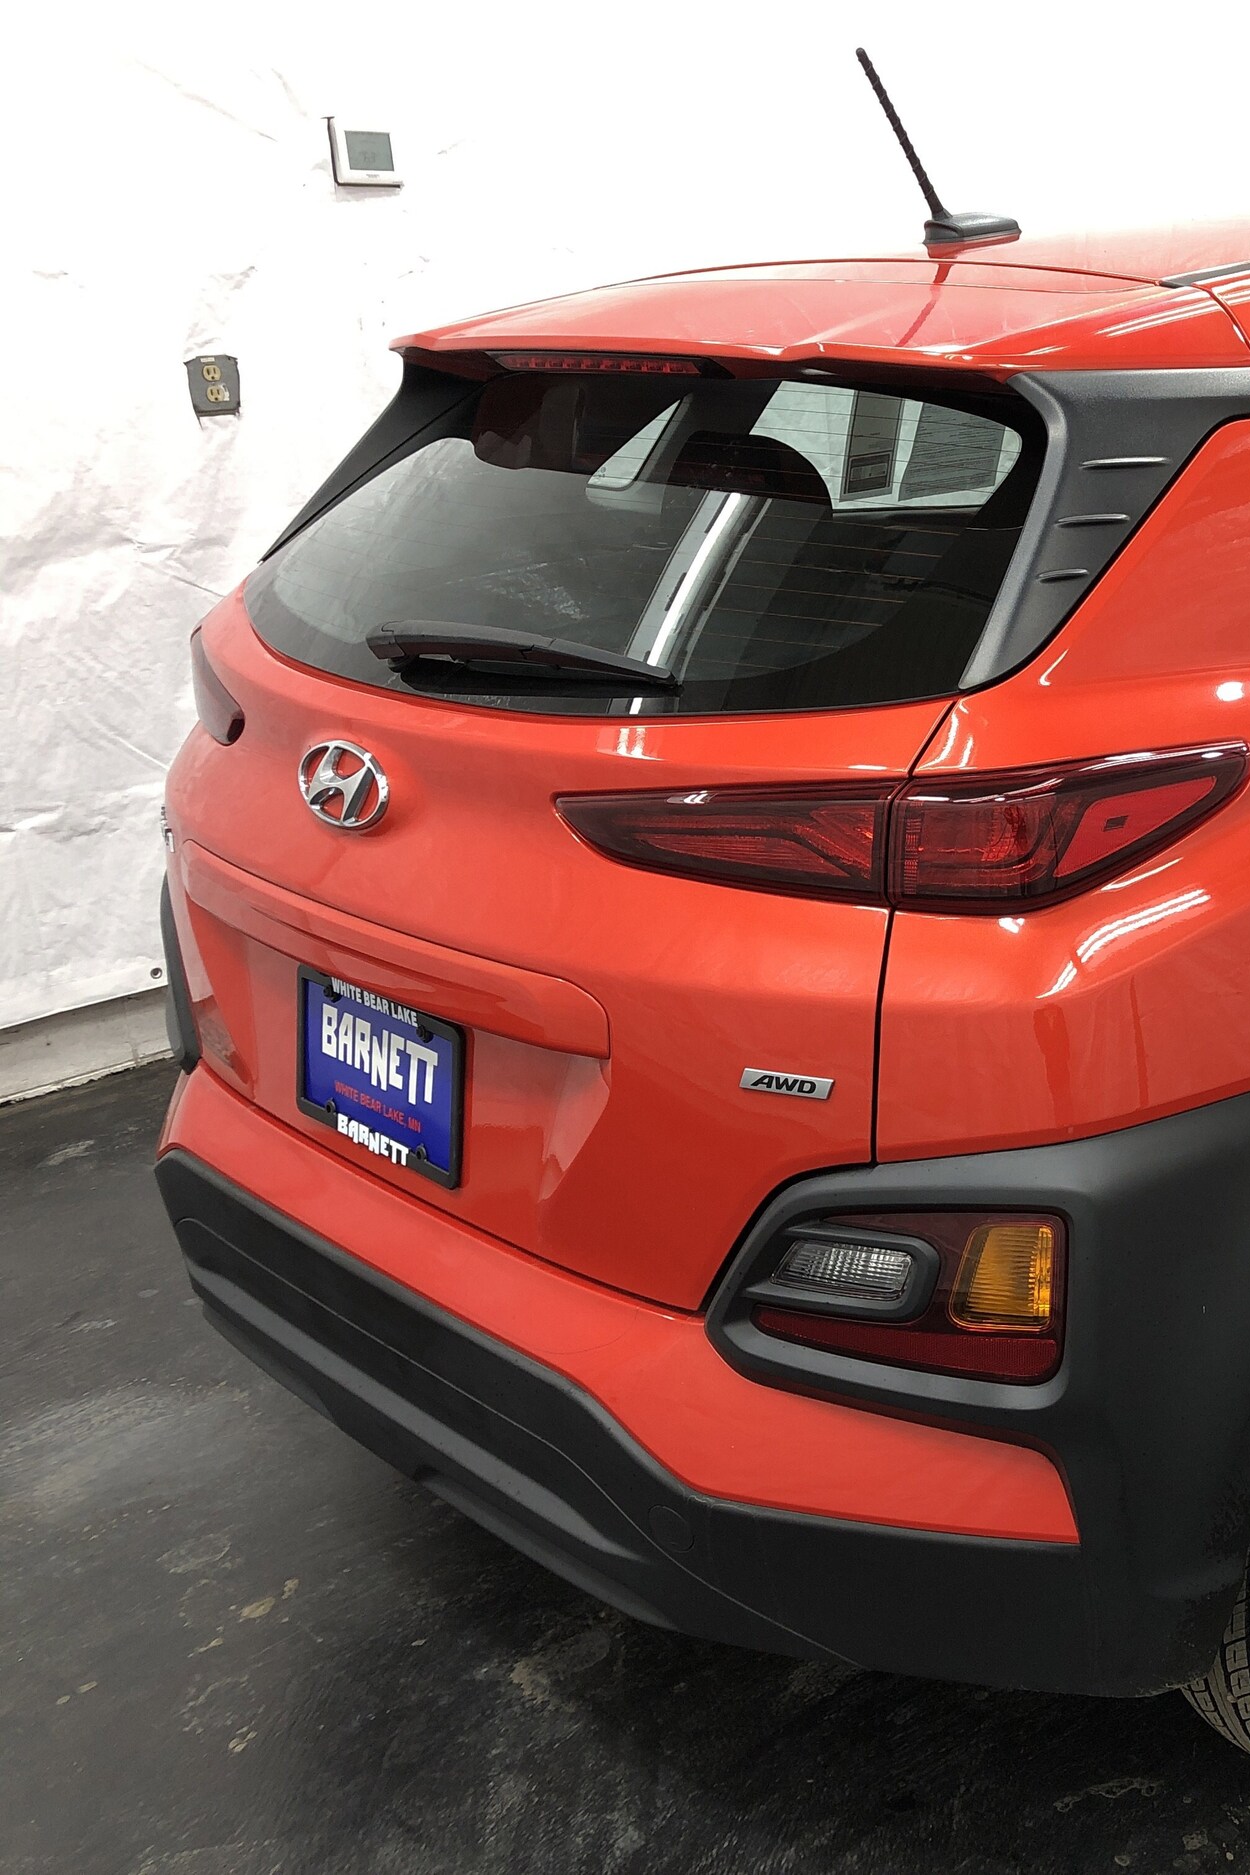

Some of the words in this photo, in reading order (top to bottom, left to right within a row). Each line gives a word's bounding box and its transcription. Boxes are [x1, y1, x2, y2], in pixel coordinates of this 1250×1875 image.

[331, 977, 362, 1003] WHITE
[363, 991, 389, 1015] BEAR
[391, 1002, 418, 1027] LAKE
[322, 1003, 438, 1105] BARNETT
[334, 1081, 359, 1102] WHITE
[360, 1094, 383, 1114] BEAR
[383, 1106, 407, 1128] LAKE,
[408, 1117, 421, 1133] MN
[750, 1075, 817, 1094] AWD
[337, 1113, 409, 1166] BARNETT
